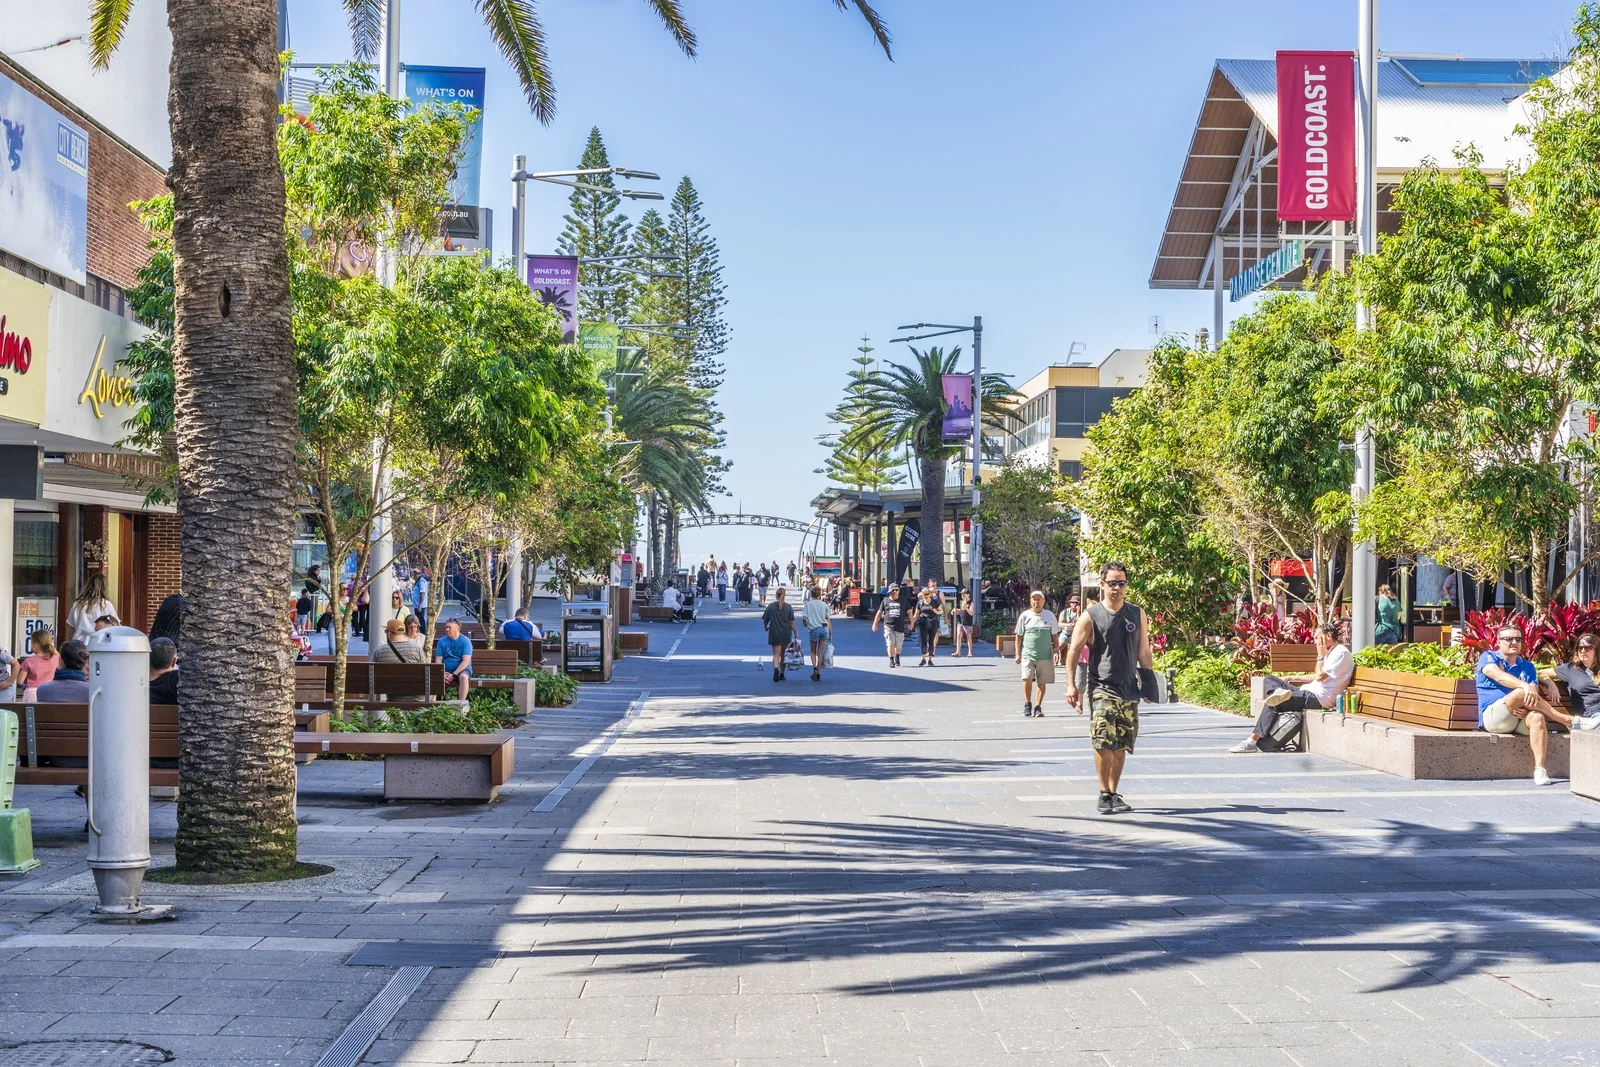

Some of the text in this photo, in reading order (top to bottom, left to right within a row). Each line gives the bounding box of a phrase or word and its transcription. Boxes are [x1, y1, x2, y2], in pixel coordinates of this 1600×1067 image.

[416, 87, 474, 98] WHAT'S ON
[59, 126, 70, 156] CITY
